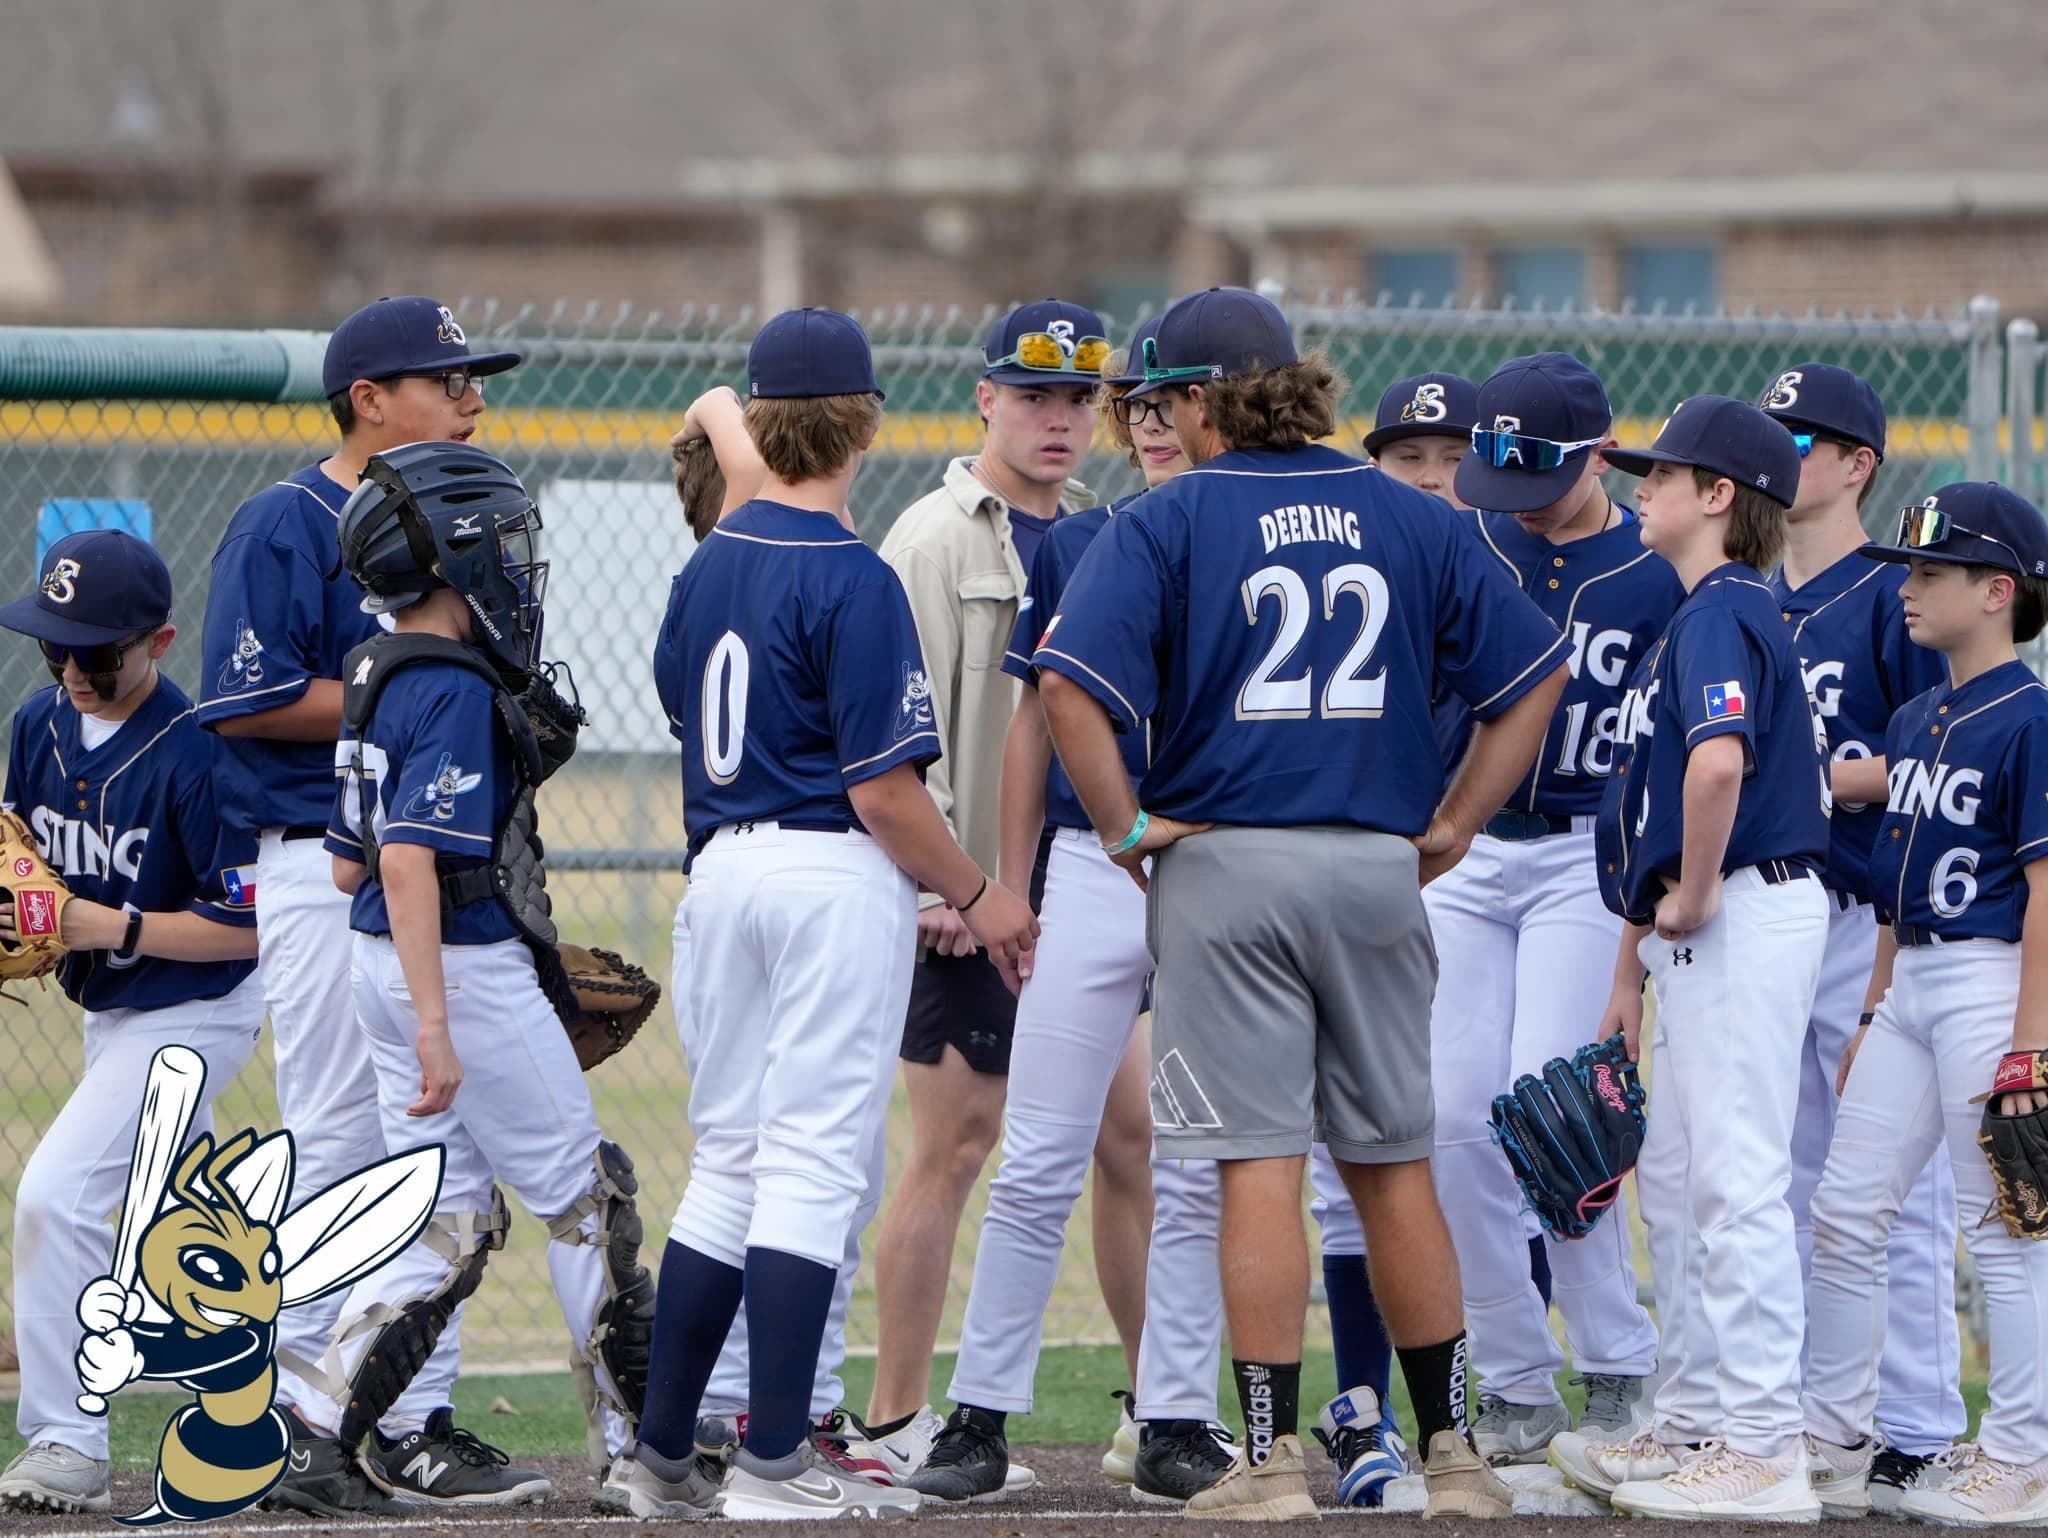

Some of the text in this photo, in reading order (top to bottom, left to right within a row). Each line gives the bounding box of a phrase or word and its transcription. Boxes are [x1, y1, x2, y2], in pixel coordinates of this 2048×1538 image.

[1408, 383, 1447, 423] S
[1768, 371, 1803, 410] S
[1258, 504, 1362, 554] DEERING
[43, 557, 80, 604] S
[465, 593, 503, 641] SAMURAI
[1235, 563, 1390, 721] 22
[702, 629, 749, 785] 0
[1553, 702, 1620, 777] 18
[30, 805, 150, 882] STING
[1929, 847, 1981, 919] 6
[28, 893, 47, 932] Rawlings
[1593, 1063, 1627, 1113] Rawlings
[1248, 1384, 1272, 1466] adidas
